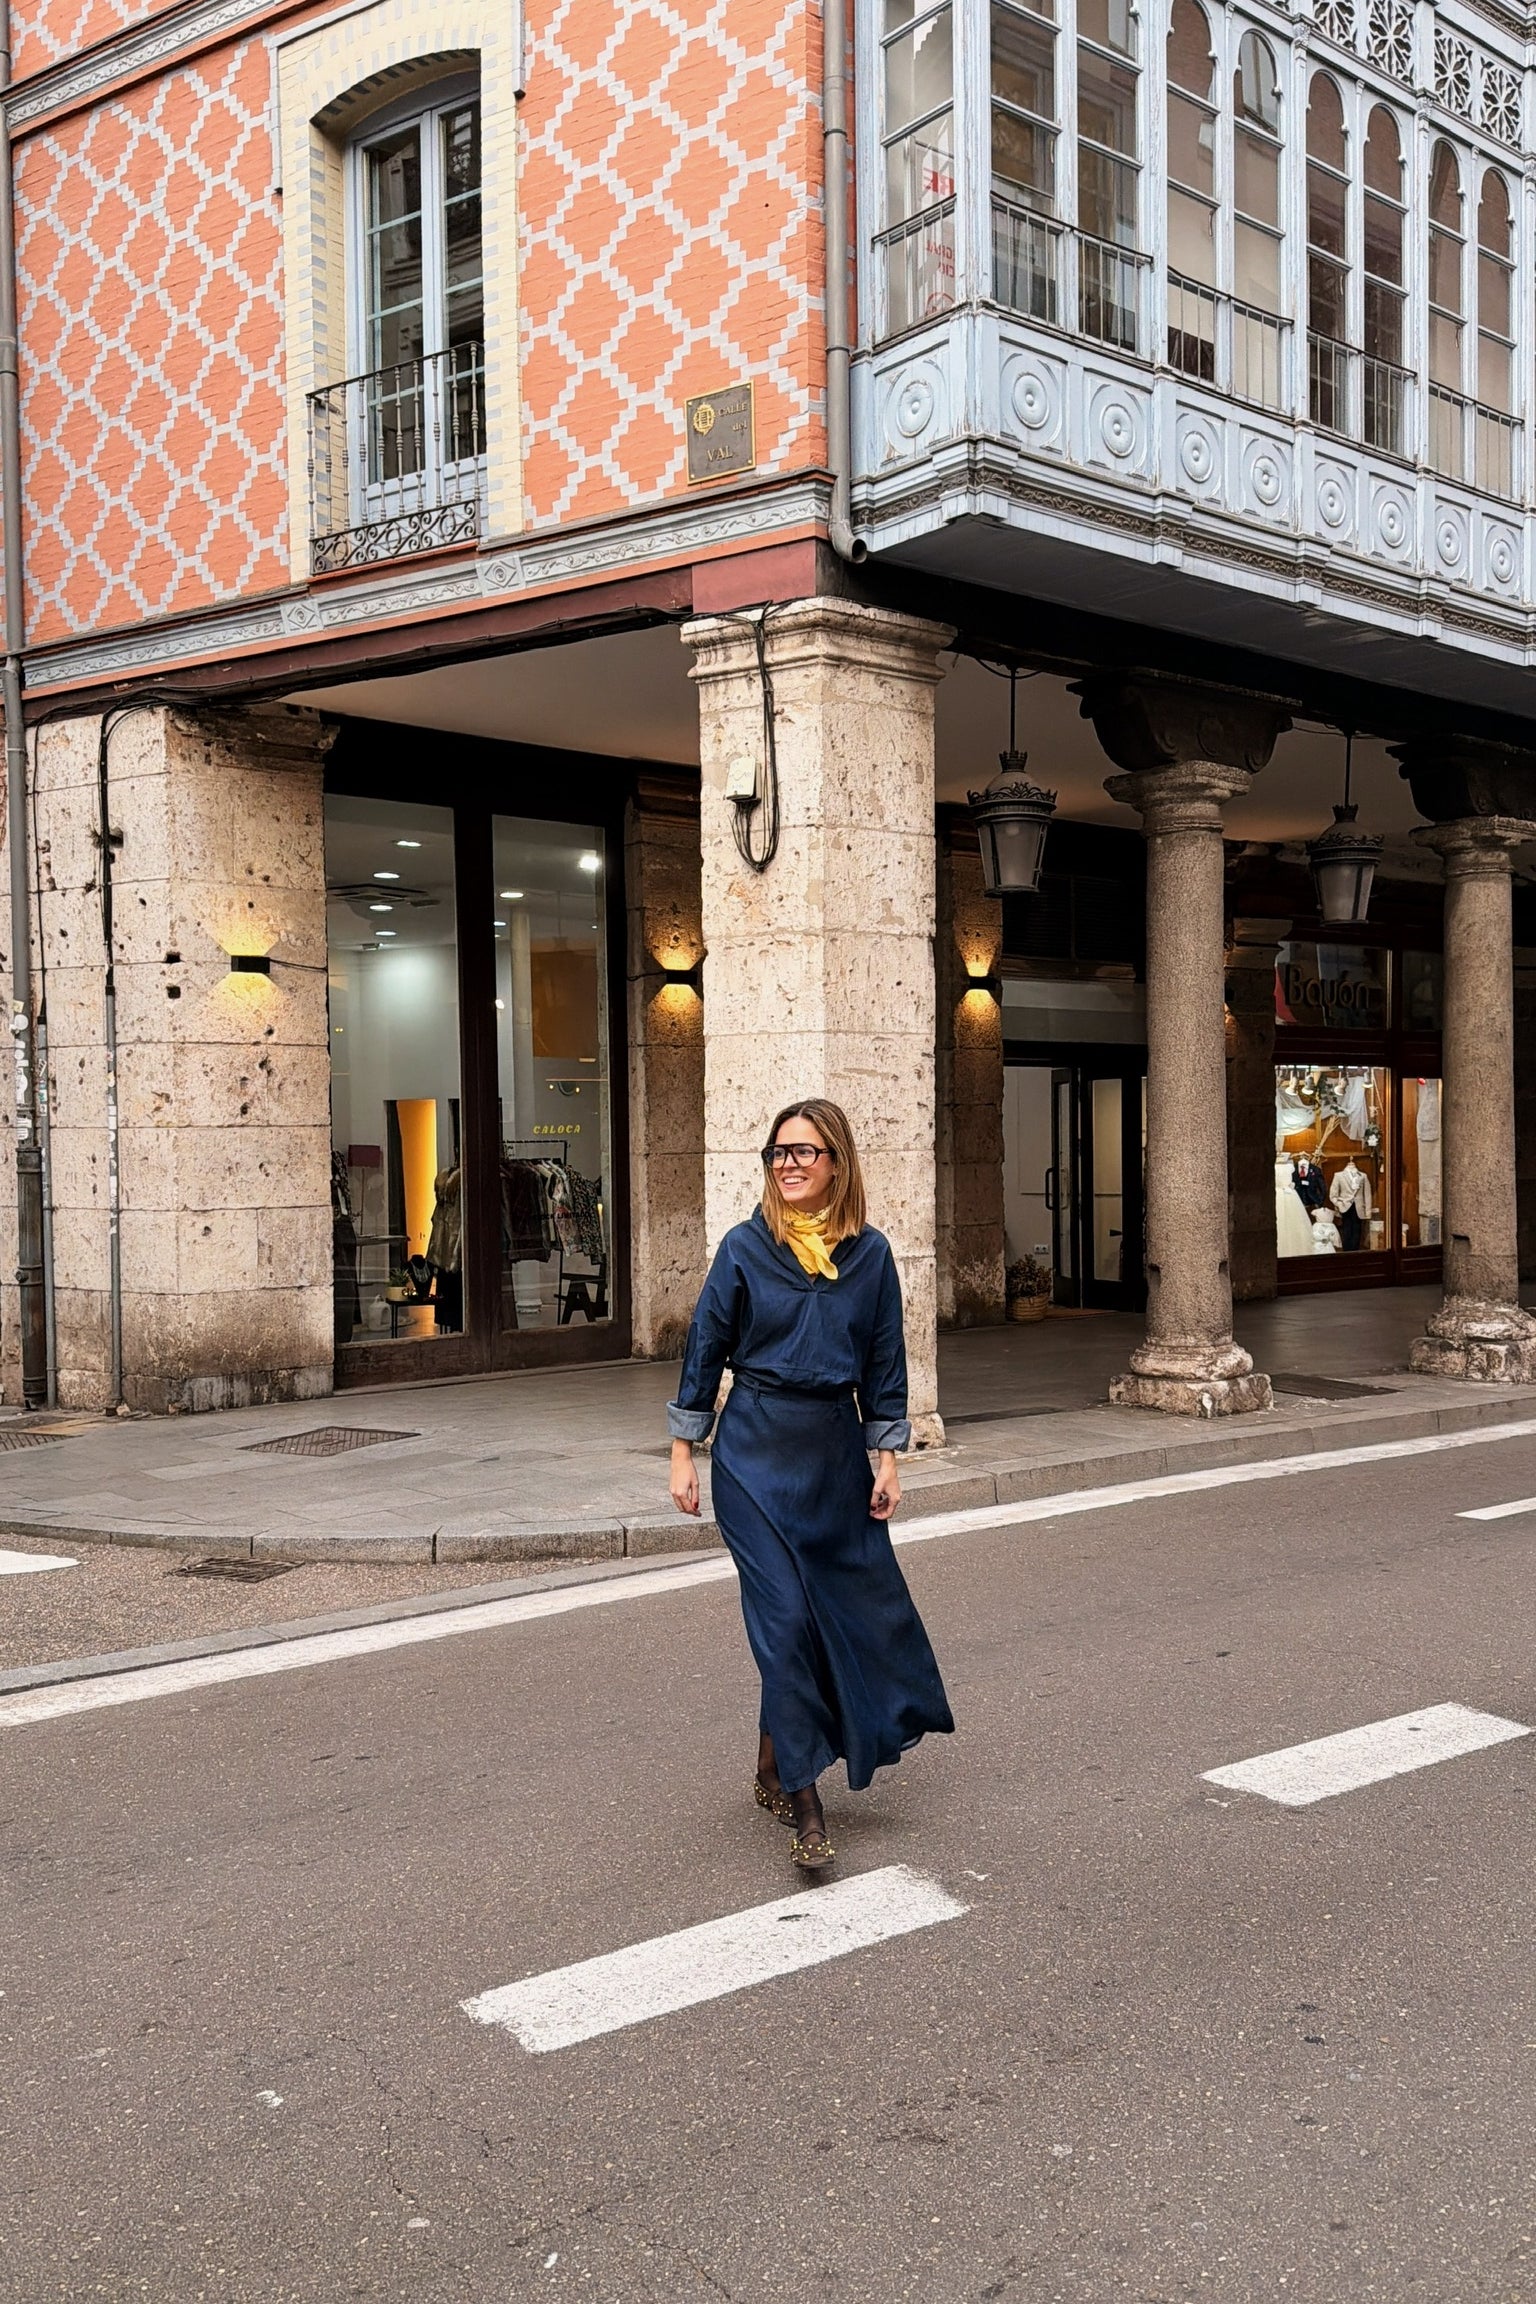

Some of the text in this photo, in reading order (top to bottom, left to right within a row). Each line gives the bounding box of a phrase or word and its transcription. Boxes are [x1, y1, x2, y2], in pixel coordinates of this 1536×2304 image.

[718, 402, 747, 417] CALLE
[706, 445, 733, 461] VAL
[532, 1124, 581, 1135] CALOCA
